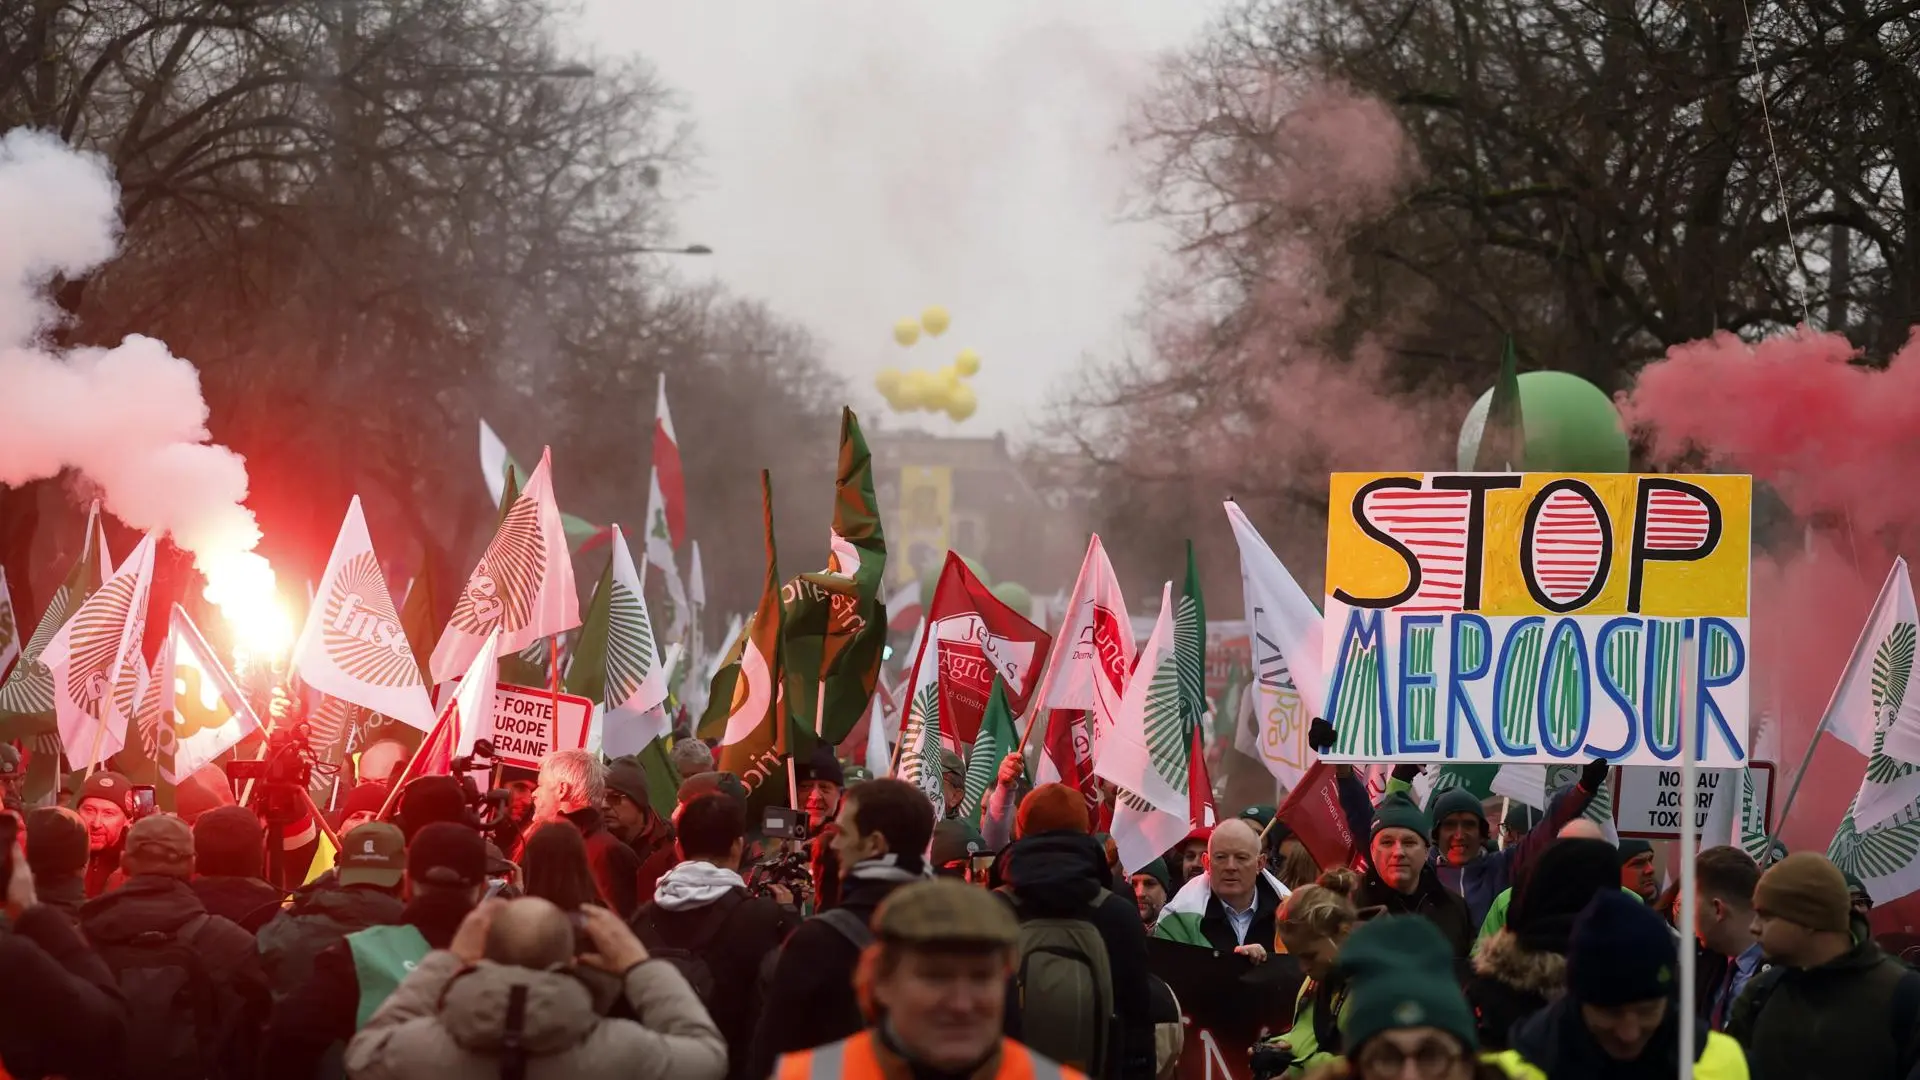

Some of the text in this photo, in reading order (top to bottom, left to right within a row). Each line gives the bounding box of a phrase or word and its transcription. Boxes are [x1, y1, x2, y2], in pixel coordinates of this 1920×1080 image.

[1332, 475, 1723, 614] STOP
[1318, 608, 1746, 761] MERCOSUR
[504, 697, 553, 720] FORTE
[495, 714, 547, 738] UROPE
[1658, 770, 1720, 788] NO AU
